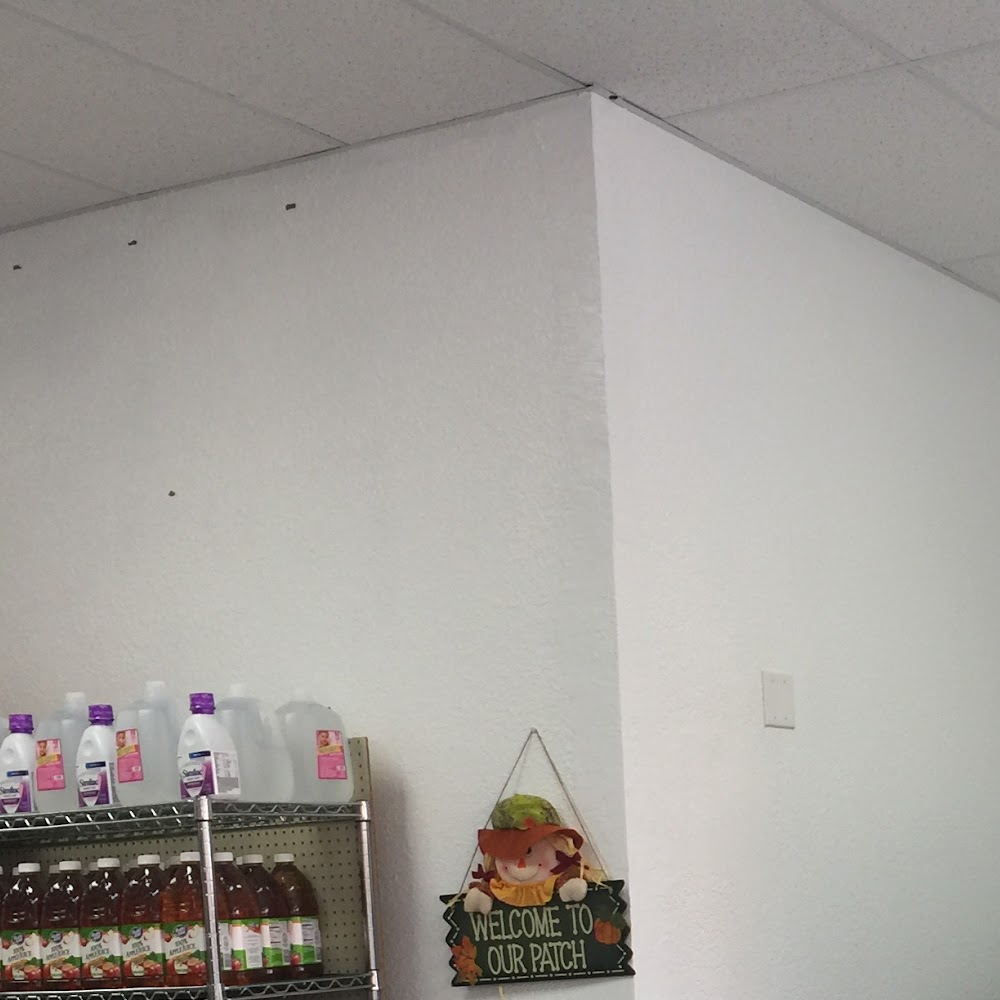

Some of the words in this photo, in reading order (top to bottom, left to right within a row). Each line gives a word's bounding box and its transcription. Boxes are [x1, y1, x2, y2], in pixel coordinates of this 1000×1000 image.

[469, 905, 562, 941] WELCOME
[565, 903, 594, 936] TO
[487, 942, 528, 976] OUR
[531, 939, 588, 973] PATCH
